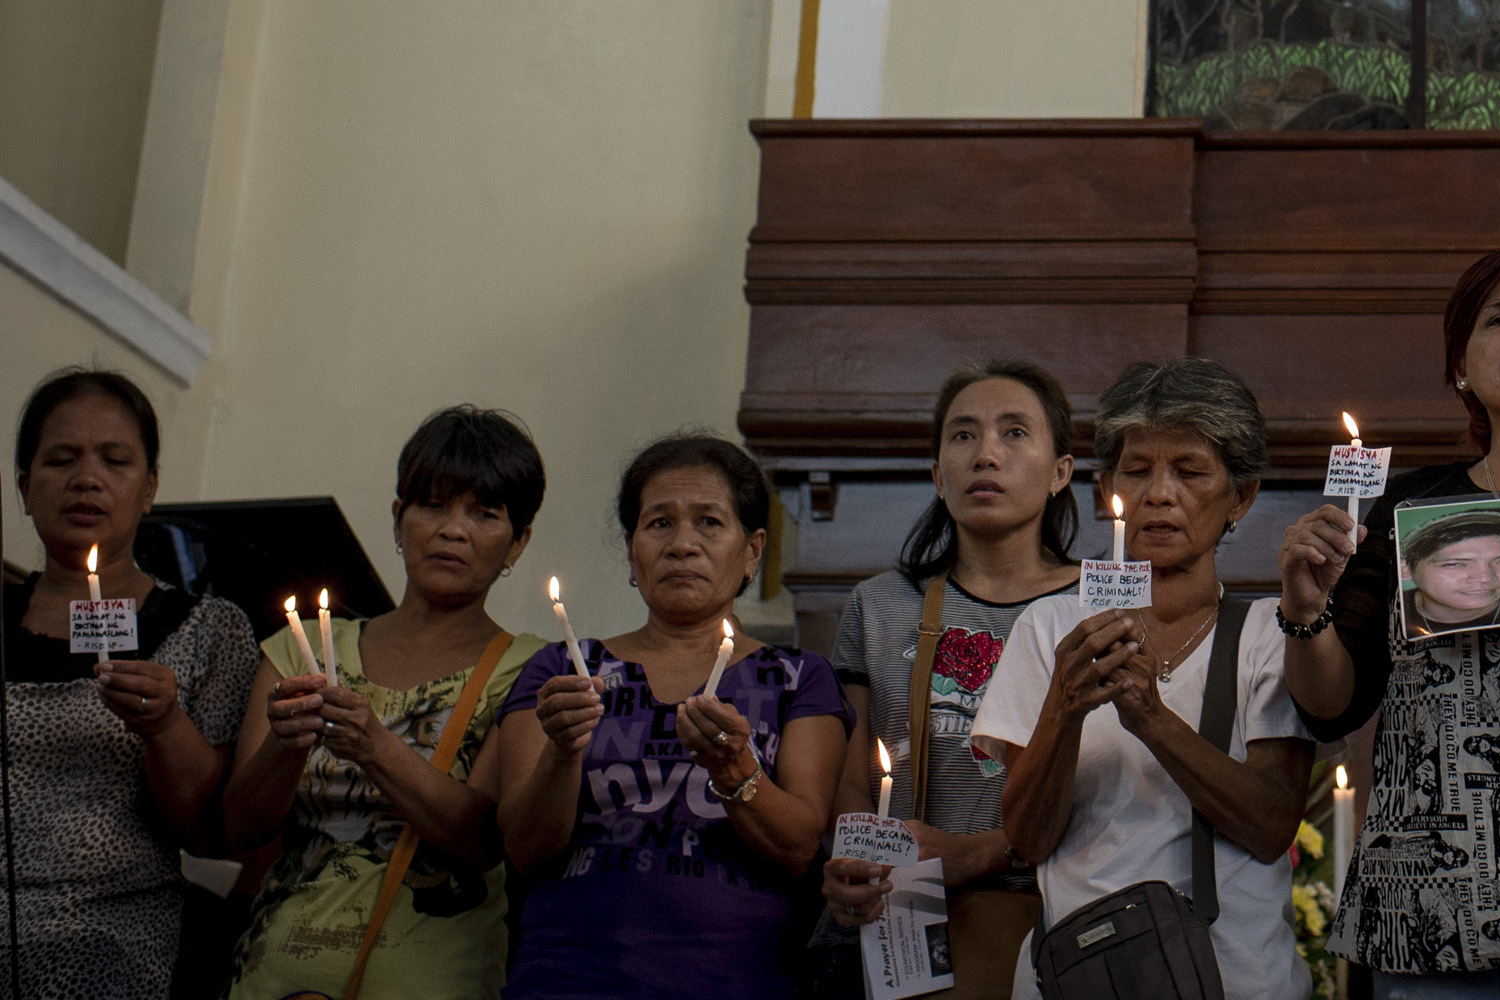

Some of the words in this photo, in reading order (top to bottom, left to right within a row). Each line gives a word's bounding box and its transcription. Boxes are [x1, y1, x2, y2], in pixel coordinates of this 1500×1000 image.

[1084, 562, 1093, 570] IN
[1086, 572, 1113, 584] POLICE
[1449, 782, 1461, 812] TRUE
[1472, 791, 1484, 821] TRUE
[839, 815, 848, 824] IN
[881, 820, 896, 828] THE
[839, 825, 871, 835] POLICE
[843, 836, 911, 856] CRIMINALS!
[1392, 860, 1429, 876] WALK
[878, 925, 888, 940] for
[881, 943, 892, 976] Prayer
[885, 979, 894, 988] A
